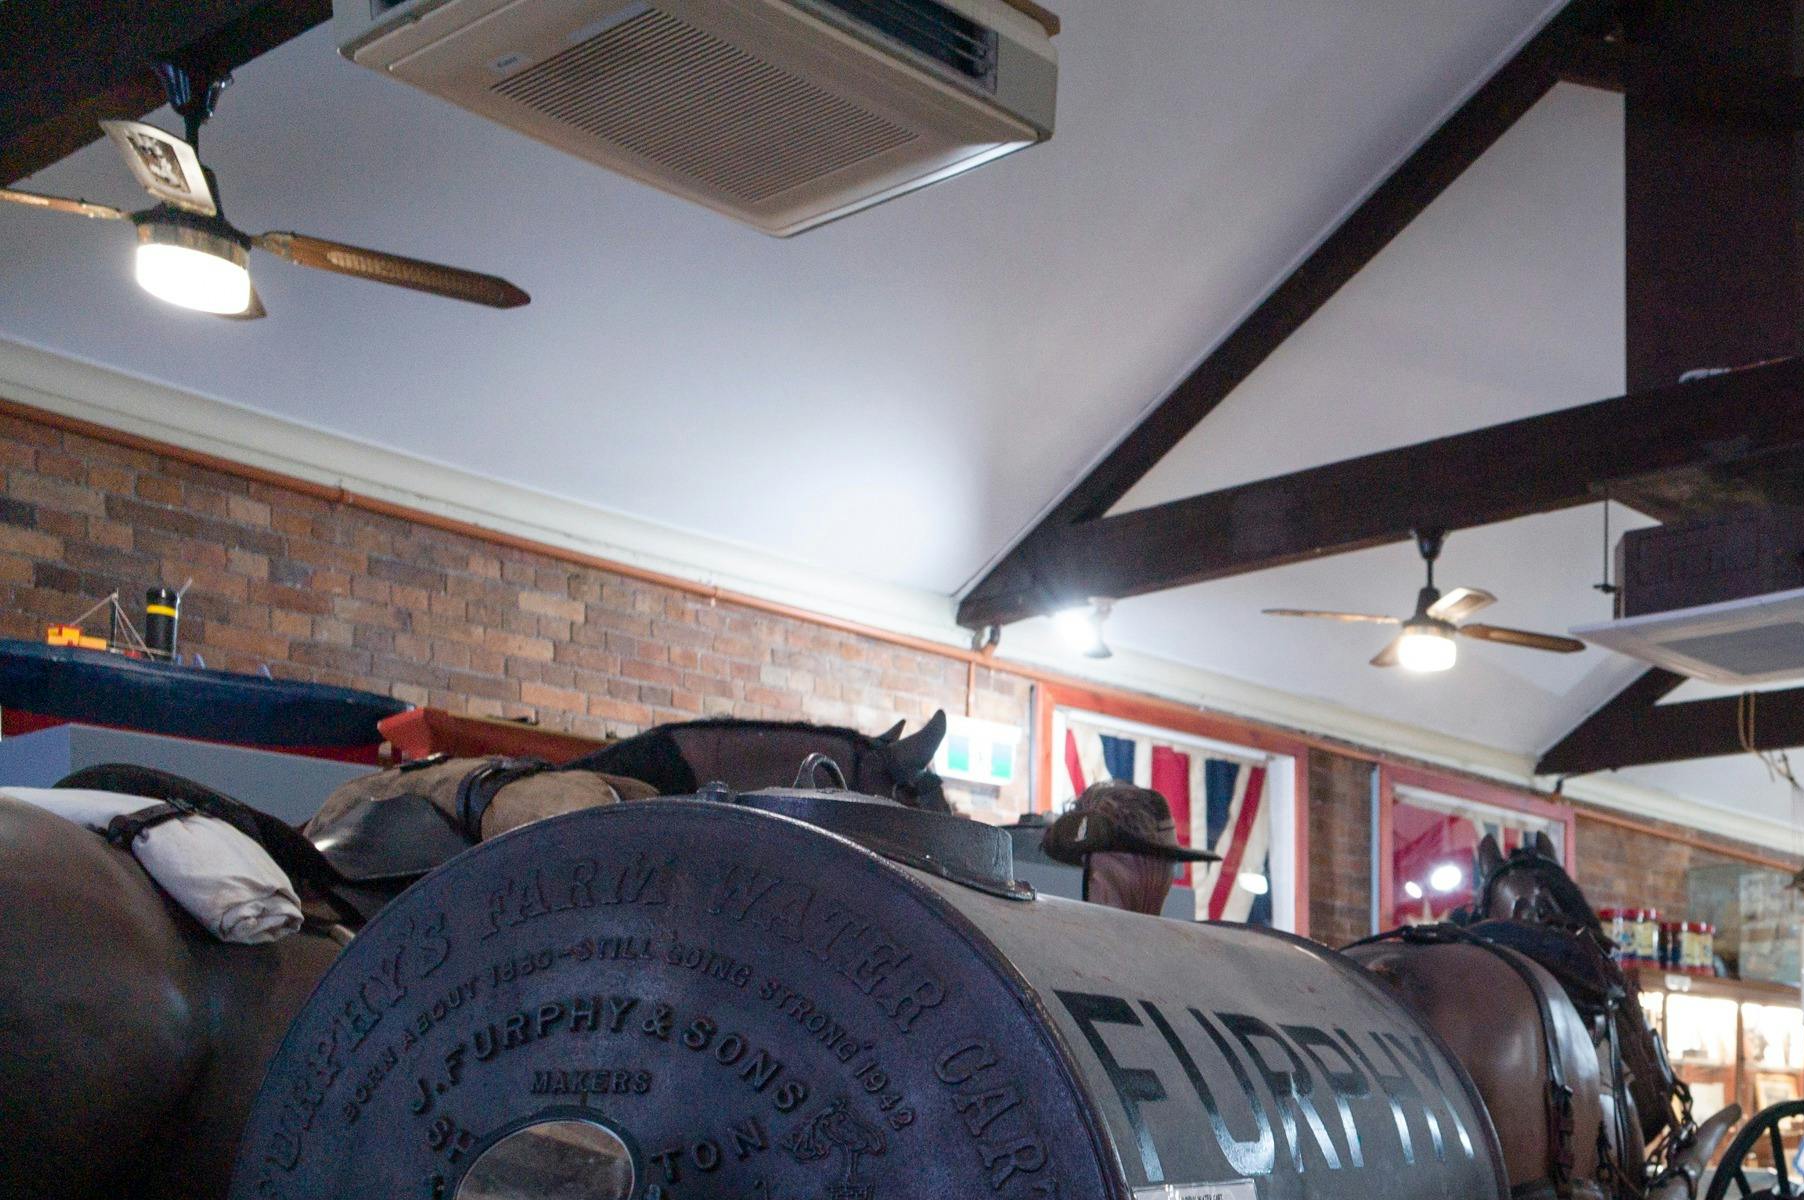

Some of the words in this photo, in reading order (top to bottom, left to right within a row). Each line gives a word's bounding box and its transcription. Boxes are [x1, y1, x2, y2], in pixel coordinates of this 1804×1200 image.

[481, 849, 673, 940] FARM
[703, 857, 950, 1037] WATER
[529, 1068, 654, 1095] MAKERS
[640, 1001, 676, 1041] &
[682, 1015, 808, 1115] SONS
[1053, 990, 1476, 1183] FURPHY
